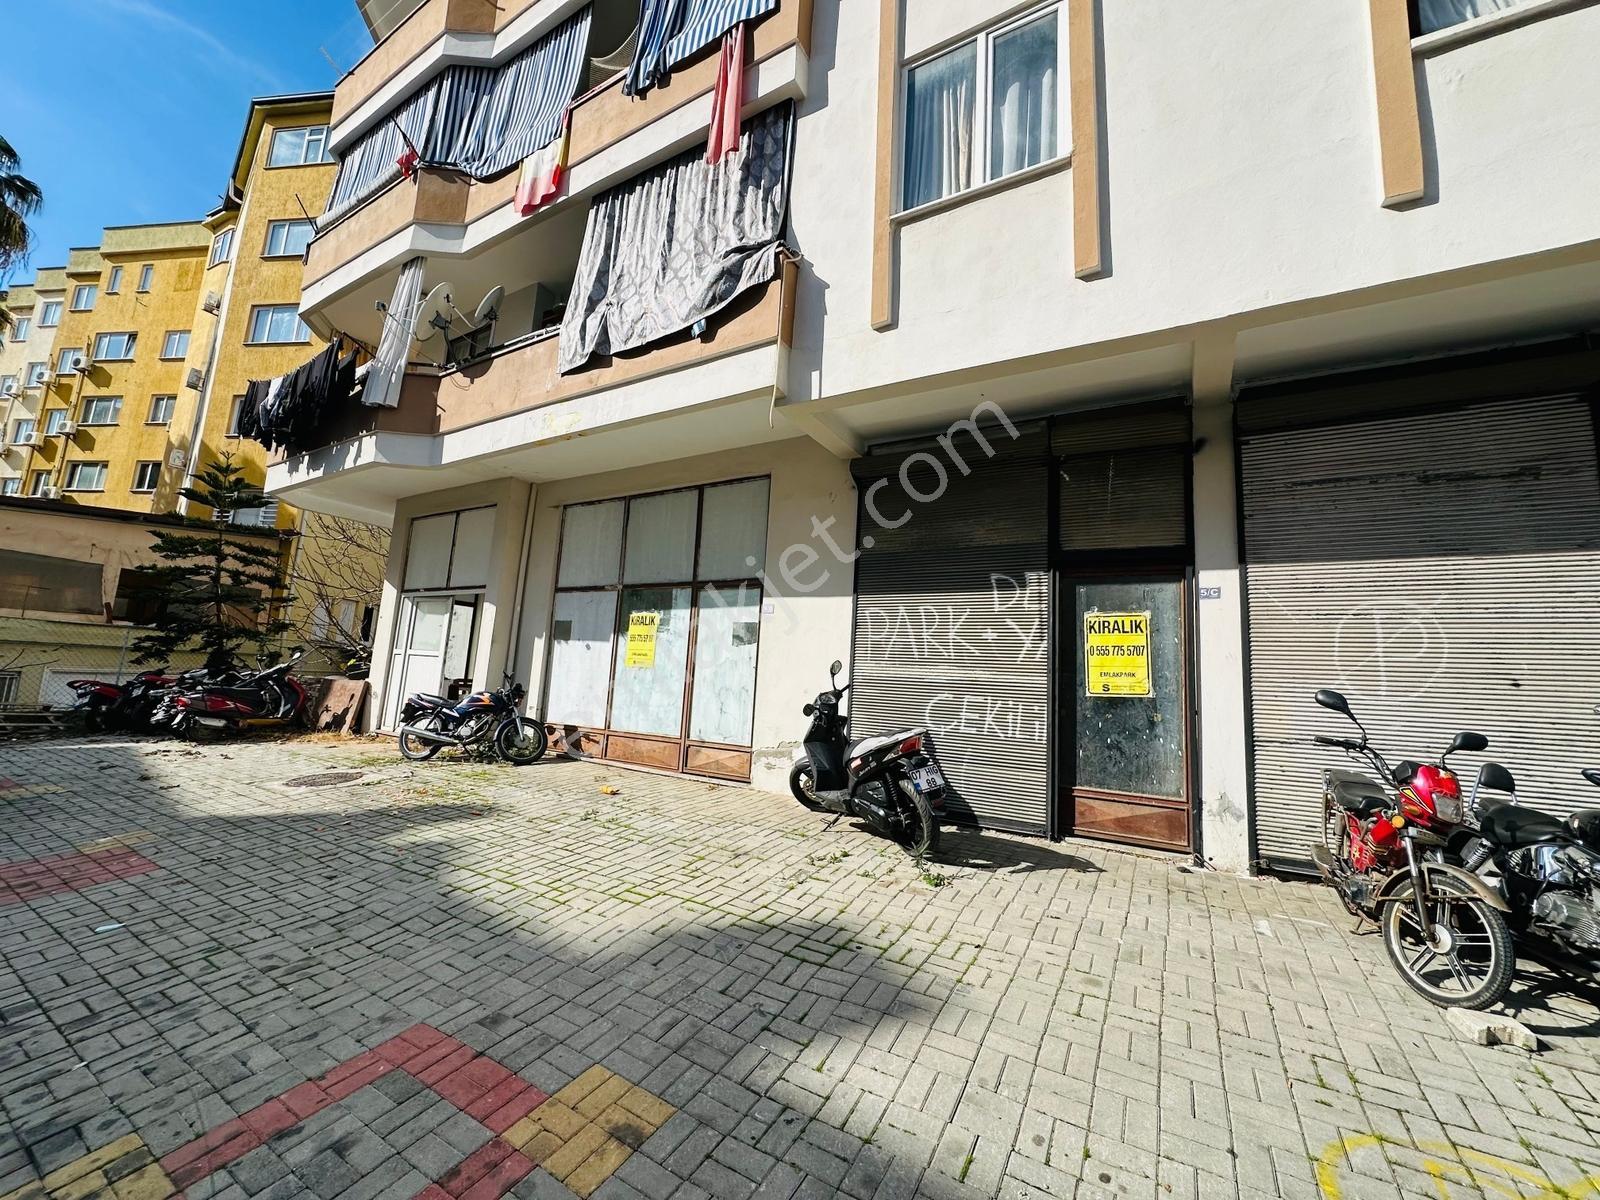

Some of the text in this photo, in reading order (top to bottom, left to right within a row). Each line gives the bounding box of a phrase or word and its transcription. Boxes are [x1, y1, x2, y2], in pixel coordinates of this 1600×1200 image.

[1088, 618, 1144, 634] KİRALIK
[863, 605, 983, 661] PARK
[1089, 645, 1145, 656] 0 555 775 5707
[911, 769, 921, 780] 07
